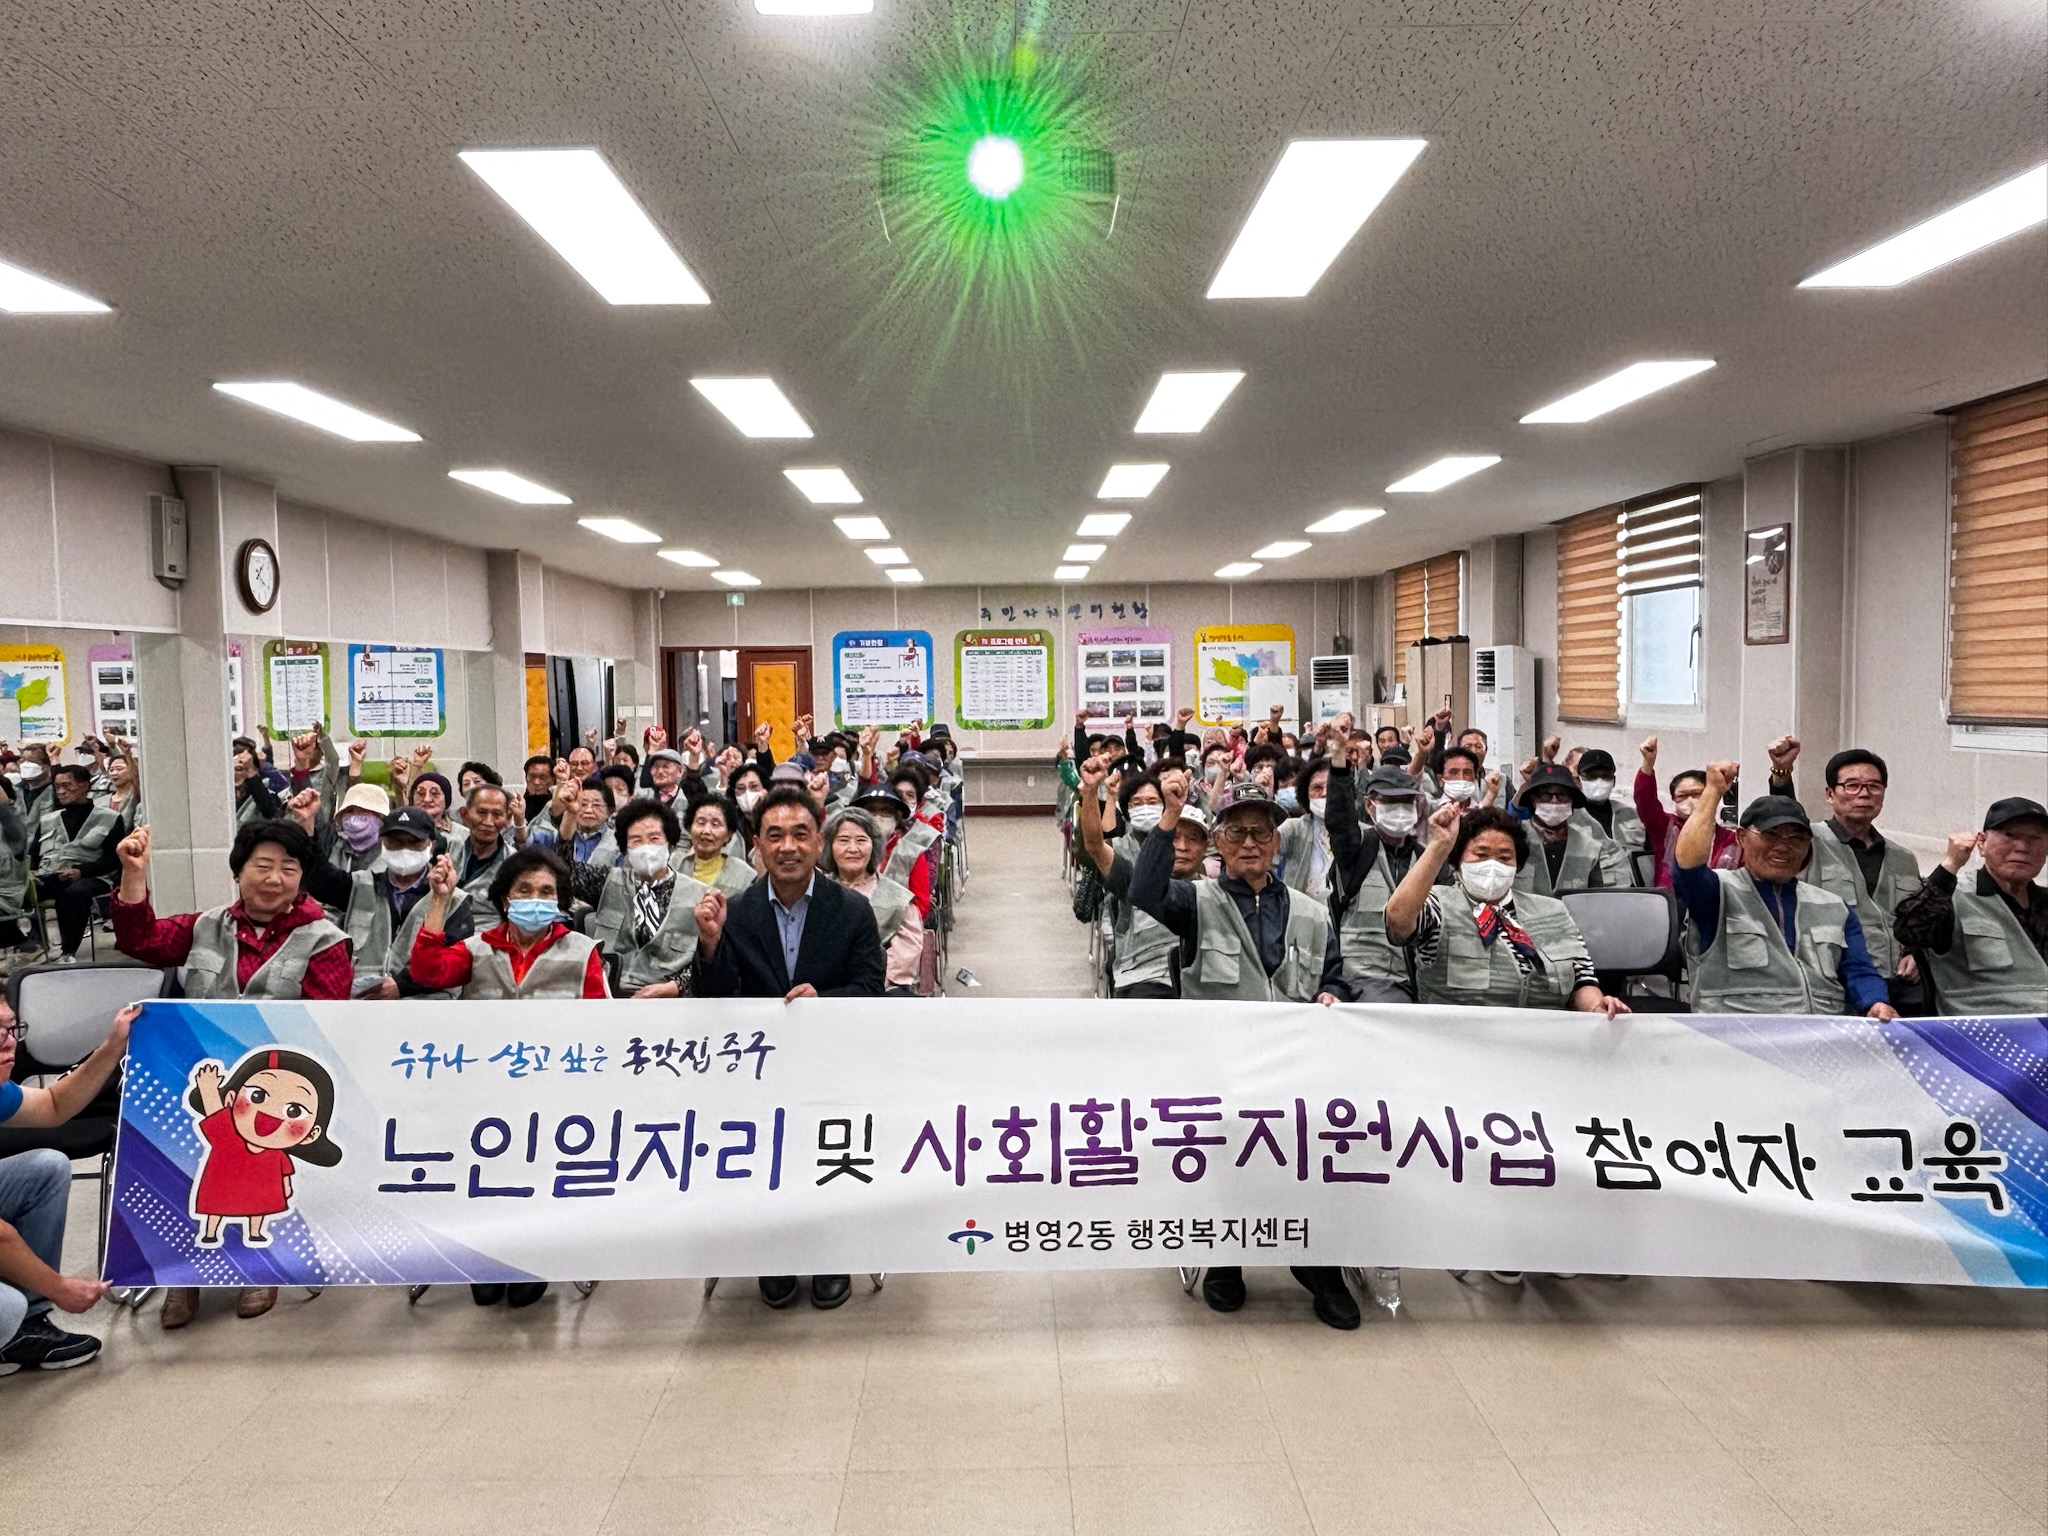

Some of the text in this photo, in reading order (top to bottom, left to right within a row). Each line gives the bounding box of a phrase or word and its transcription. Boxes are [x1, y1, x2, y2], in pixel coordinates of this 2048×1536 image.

[391, 1041, 479, 1079] 누구나
[487, 1041, 551, 1078] 살고
[560, 1043, 609, 1073] 싶은
[377, 1096, 2004, 1210] 노인일자리 및 사회활동지원사업 참여자 교육
[1005, 1218, 1309, 1252] 병영2동 행정복지센터
